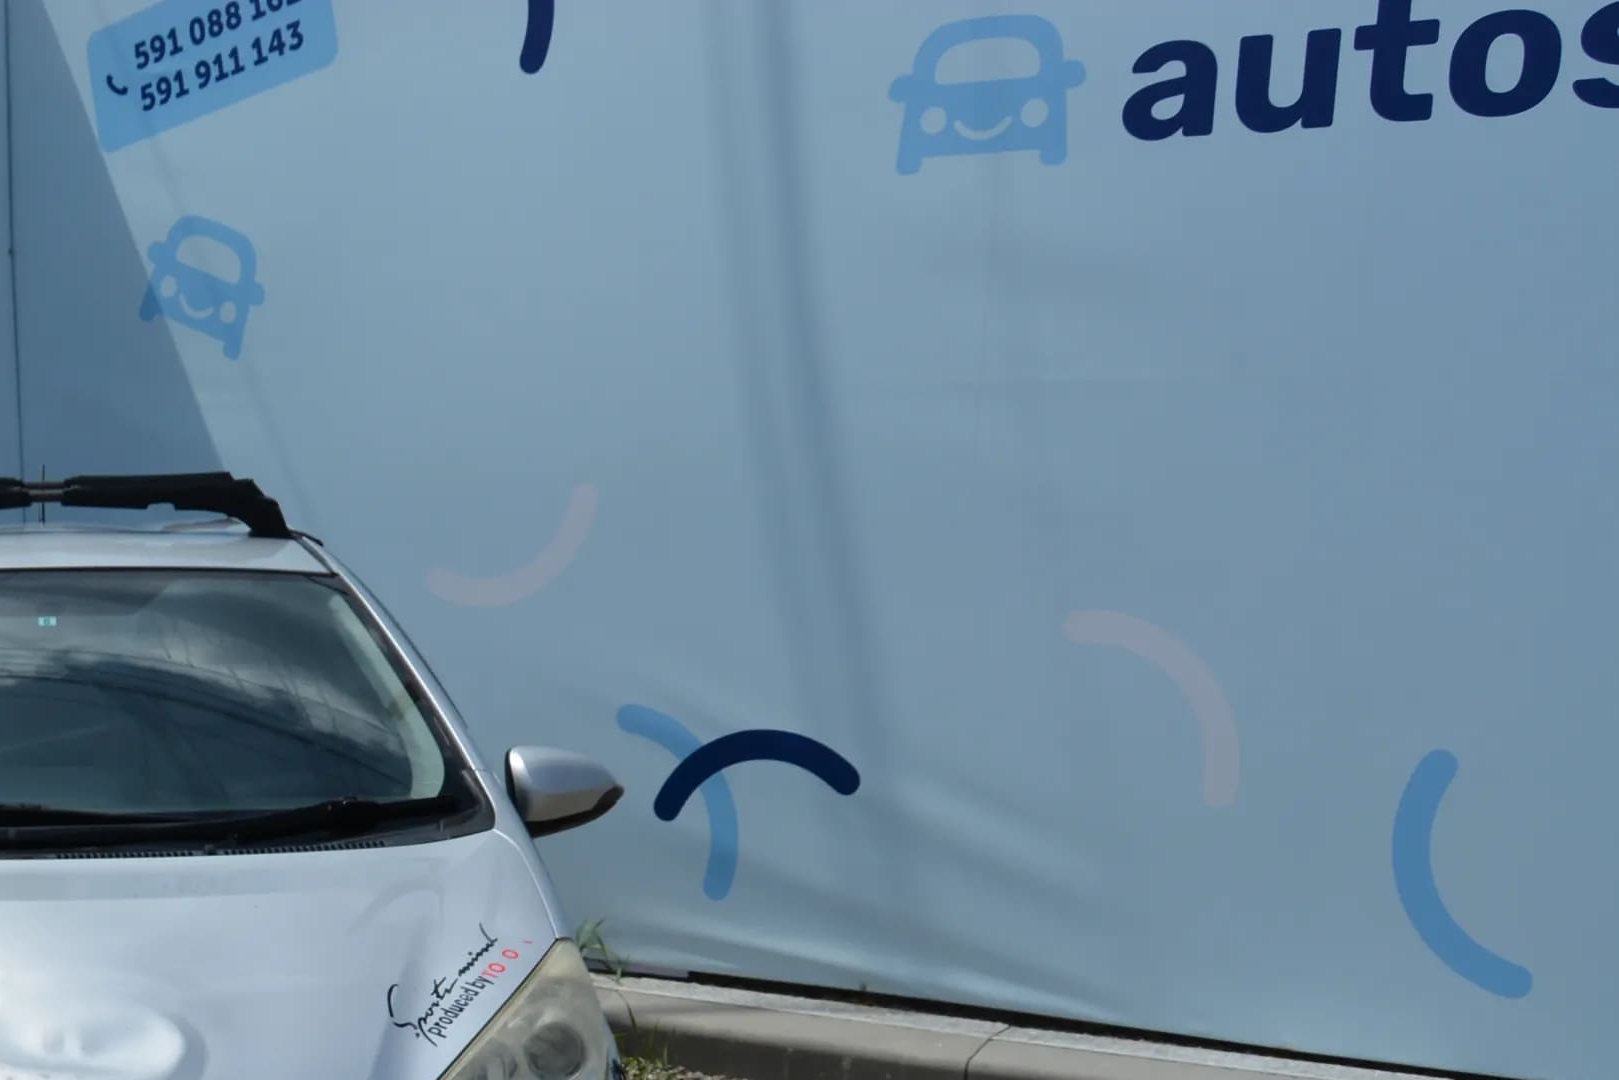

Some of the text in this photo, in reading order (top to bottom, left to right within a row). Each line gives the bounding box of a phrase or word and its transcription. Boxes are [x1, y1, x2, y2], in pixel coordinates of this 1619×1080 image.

[134, 27, 184, 70] 591
[188, 0, 242, 46] 088
[140, 19, 304, 112] 591 911 143
[427, 986, 480, 1039] produced
[464, 975, 495, 990] by
